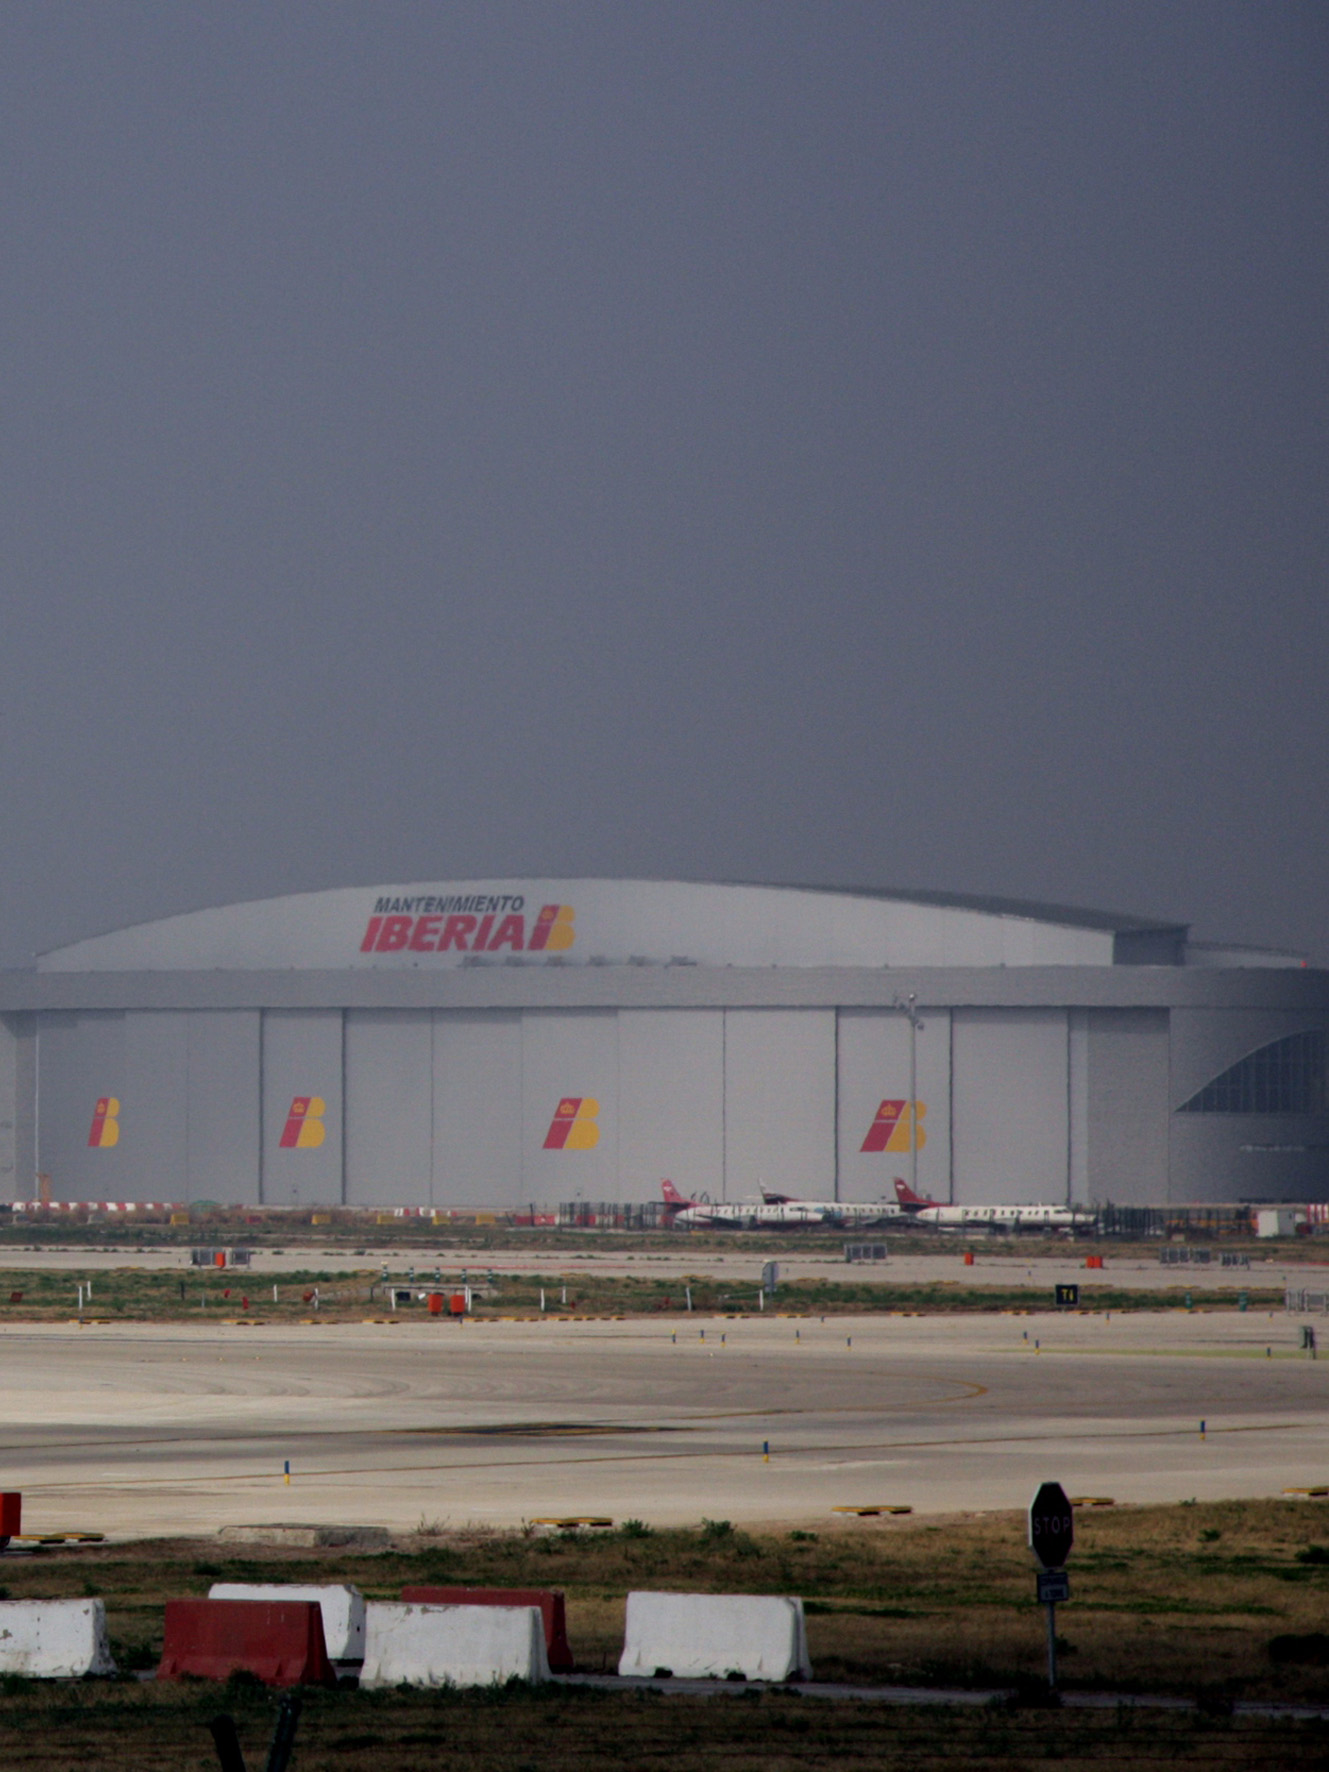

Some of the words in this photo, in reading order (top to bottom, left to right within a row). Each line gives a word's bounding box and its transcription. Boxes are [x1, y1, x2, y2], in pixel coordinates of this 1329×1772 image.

[374, 896, 525, 914] MANTENIMIENTO
[360, 914, 525, 952] IBERIA
[1034, 1515, 1071, 1535] STOP
